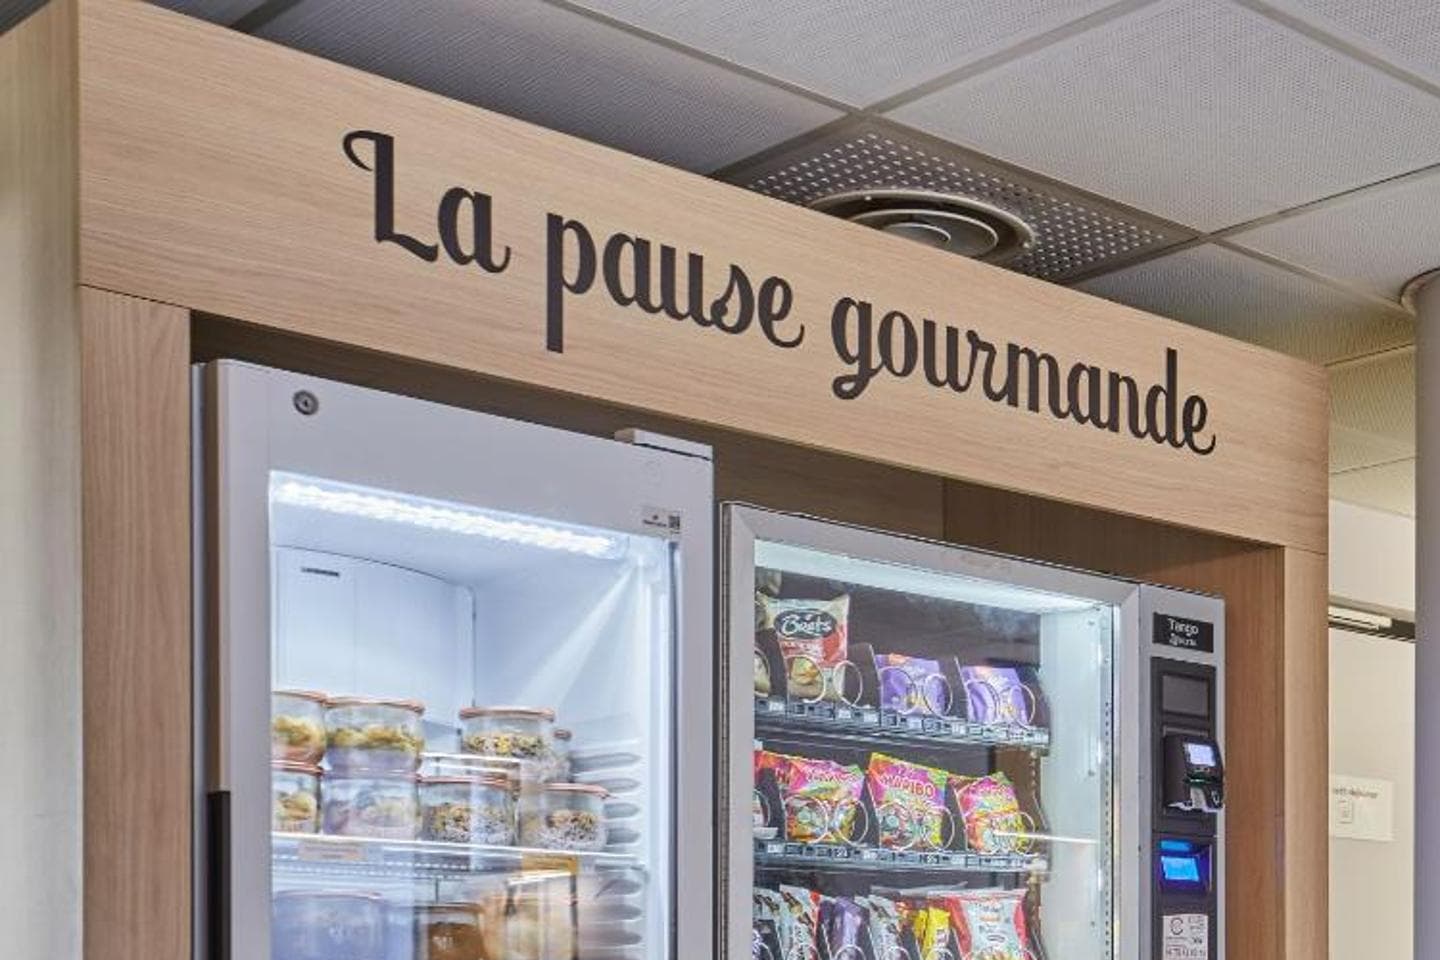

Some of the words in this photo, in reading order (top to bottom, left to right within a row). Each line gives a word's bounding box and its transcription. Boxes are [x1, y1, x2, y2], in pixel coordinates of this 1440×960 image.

[343, 130, 511, 274] La
[546, 212, 805, 353] pause
[830, 296, 1217, 456] gourmande
